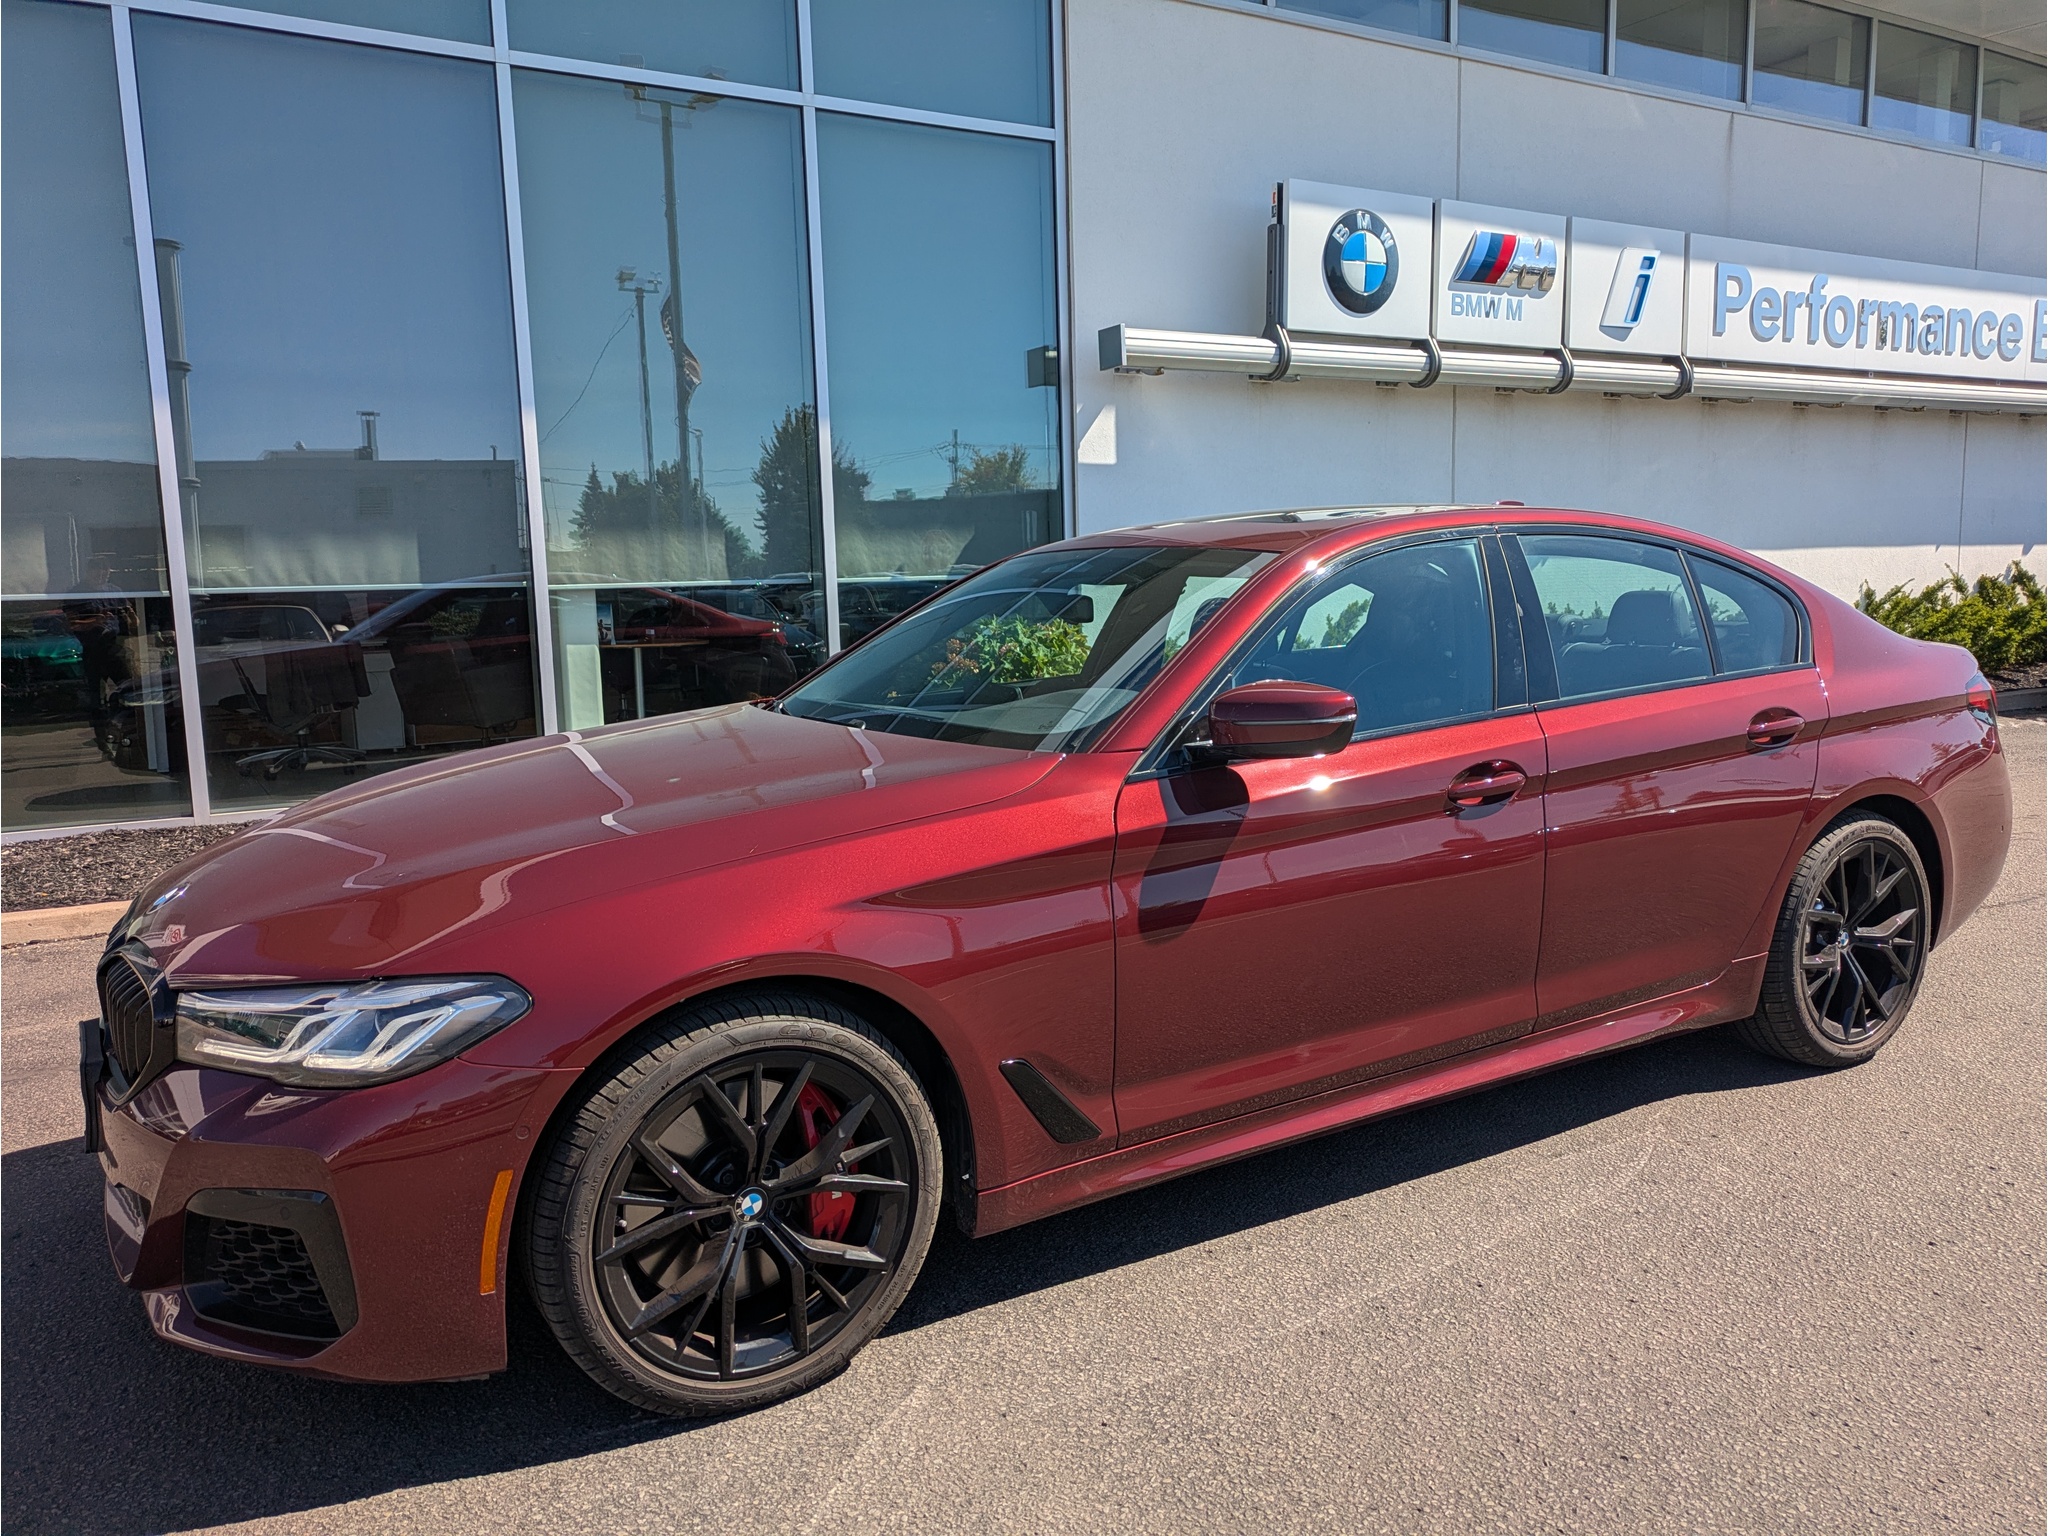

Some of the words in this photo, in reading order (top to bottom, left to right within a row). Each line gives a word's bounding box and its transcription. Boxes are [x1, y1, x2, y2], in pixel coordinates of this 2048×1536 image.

[1332, 211, 1394, 249] BMW
[1451, 293, 1502, 320] BMW
[1505, 298, 1523, 321] M
[1712, 262, 2024, 362] Performance
[778, 1023, 932, 1147] GOODYEAR
